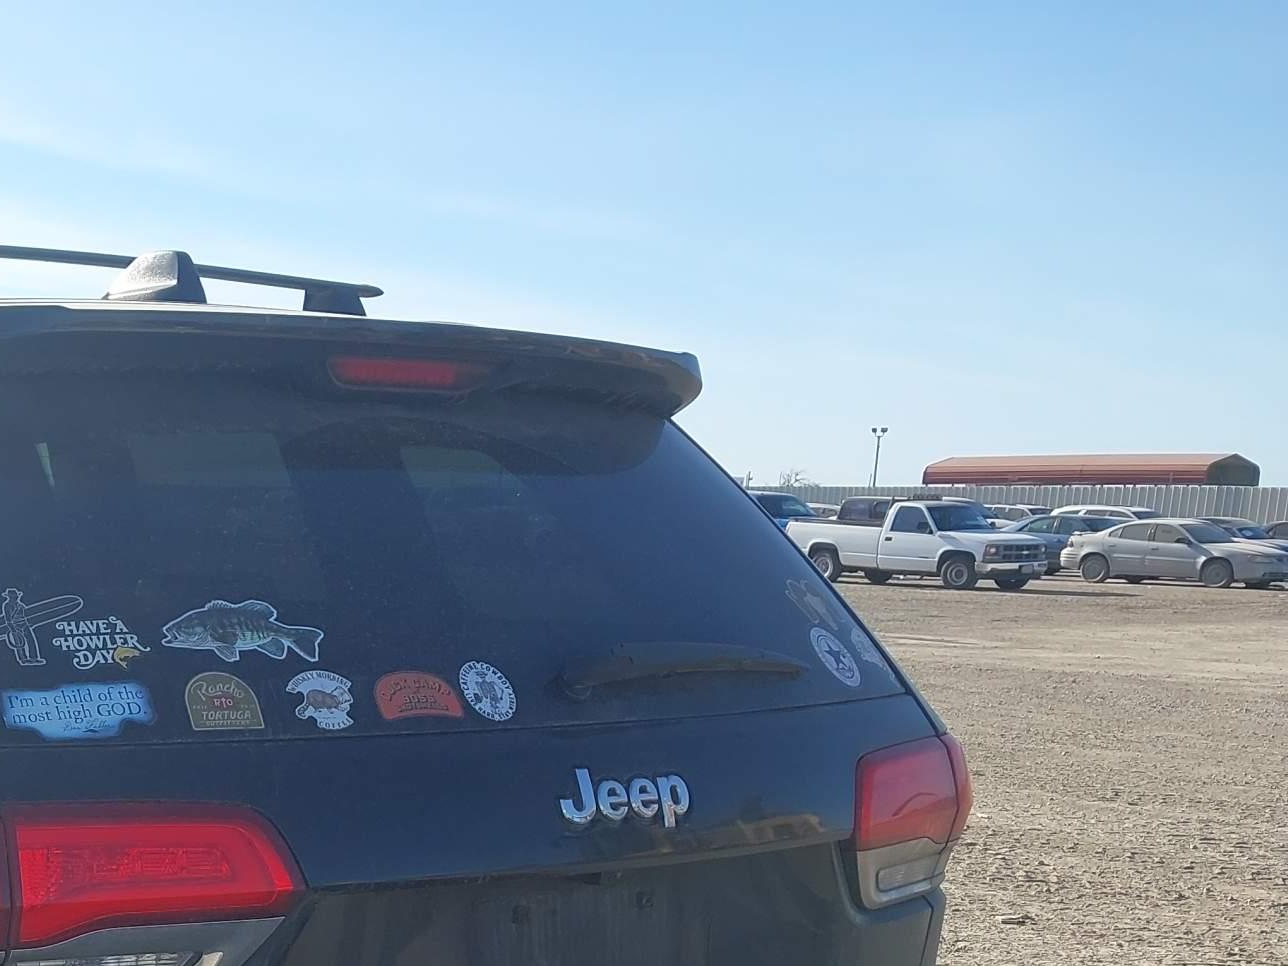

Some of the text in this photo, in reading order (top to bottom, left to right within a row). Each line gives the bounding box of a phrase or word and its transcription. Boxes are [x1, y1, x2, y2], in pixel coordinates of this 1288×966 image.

[55, 616, 129, 635] HAVE A
[52, 634, 151, 652] HOWLER
[73, 650, 114, 670] DAY
[481, 664, 512, 690] COWBOY
[7, 686, 145, 709] I'm a child of the
[12, 702, 148, 724] most high GOD.
[201, 710, 252, 721] TORTUGA
[560, 768, 690, 828] Jeep
